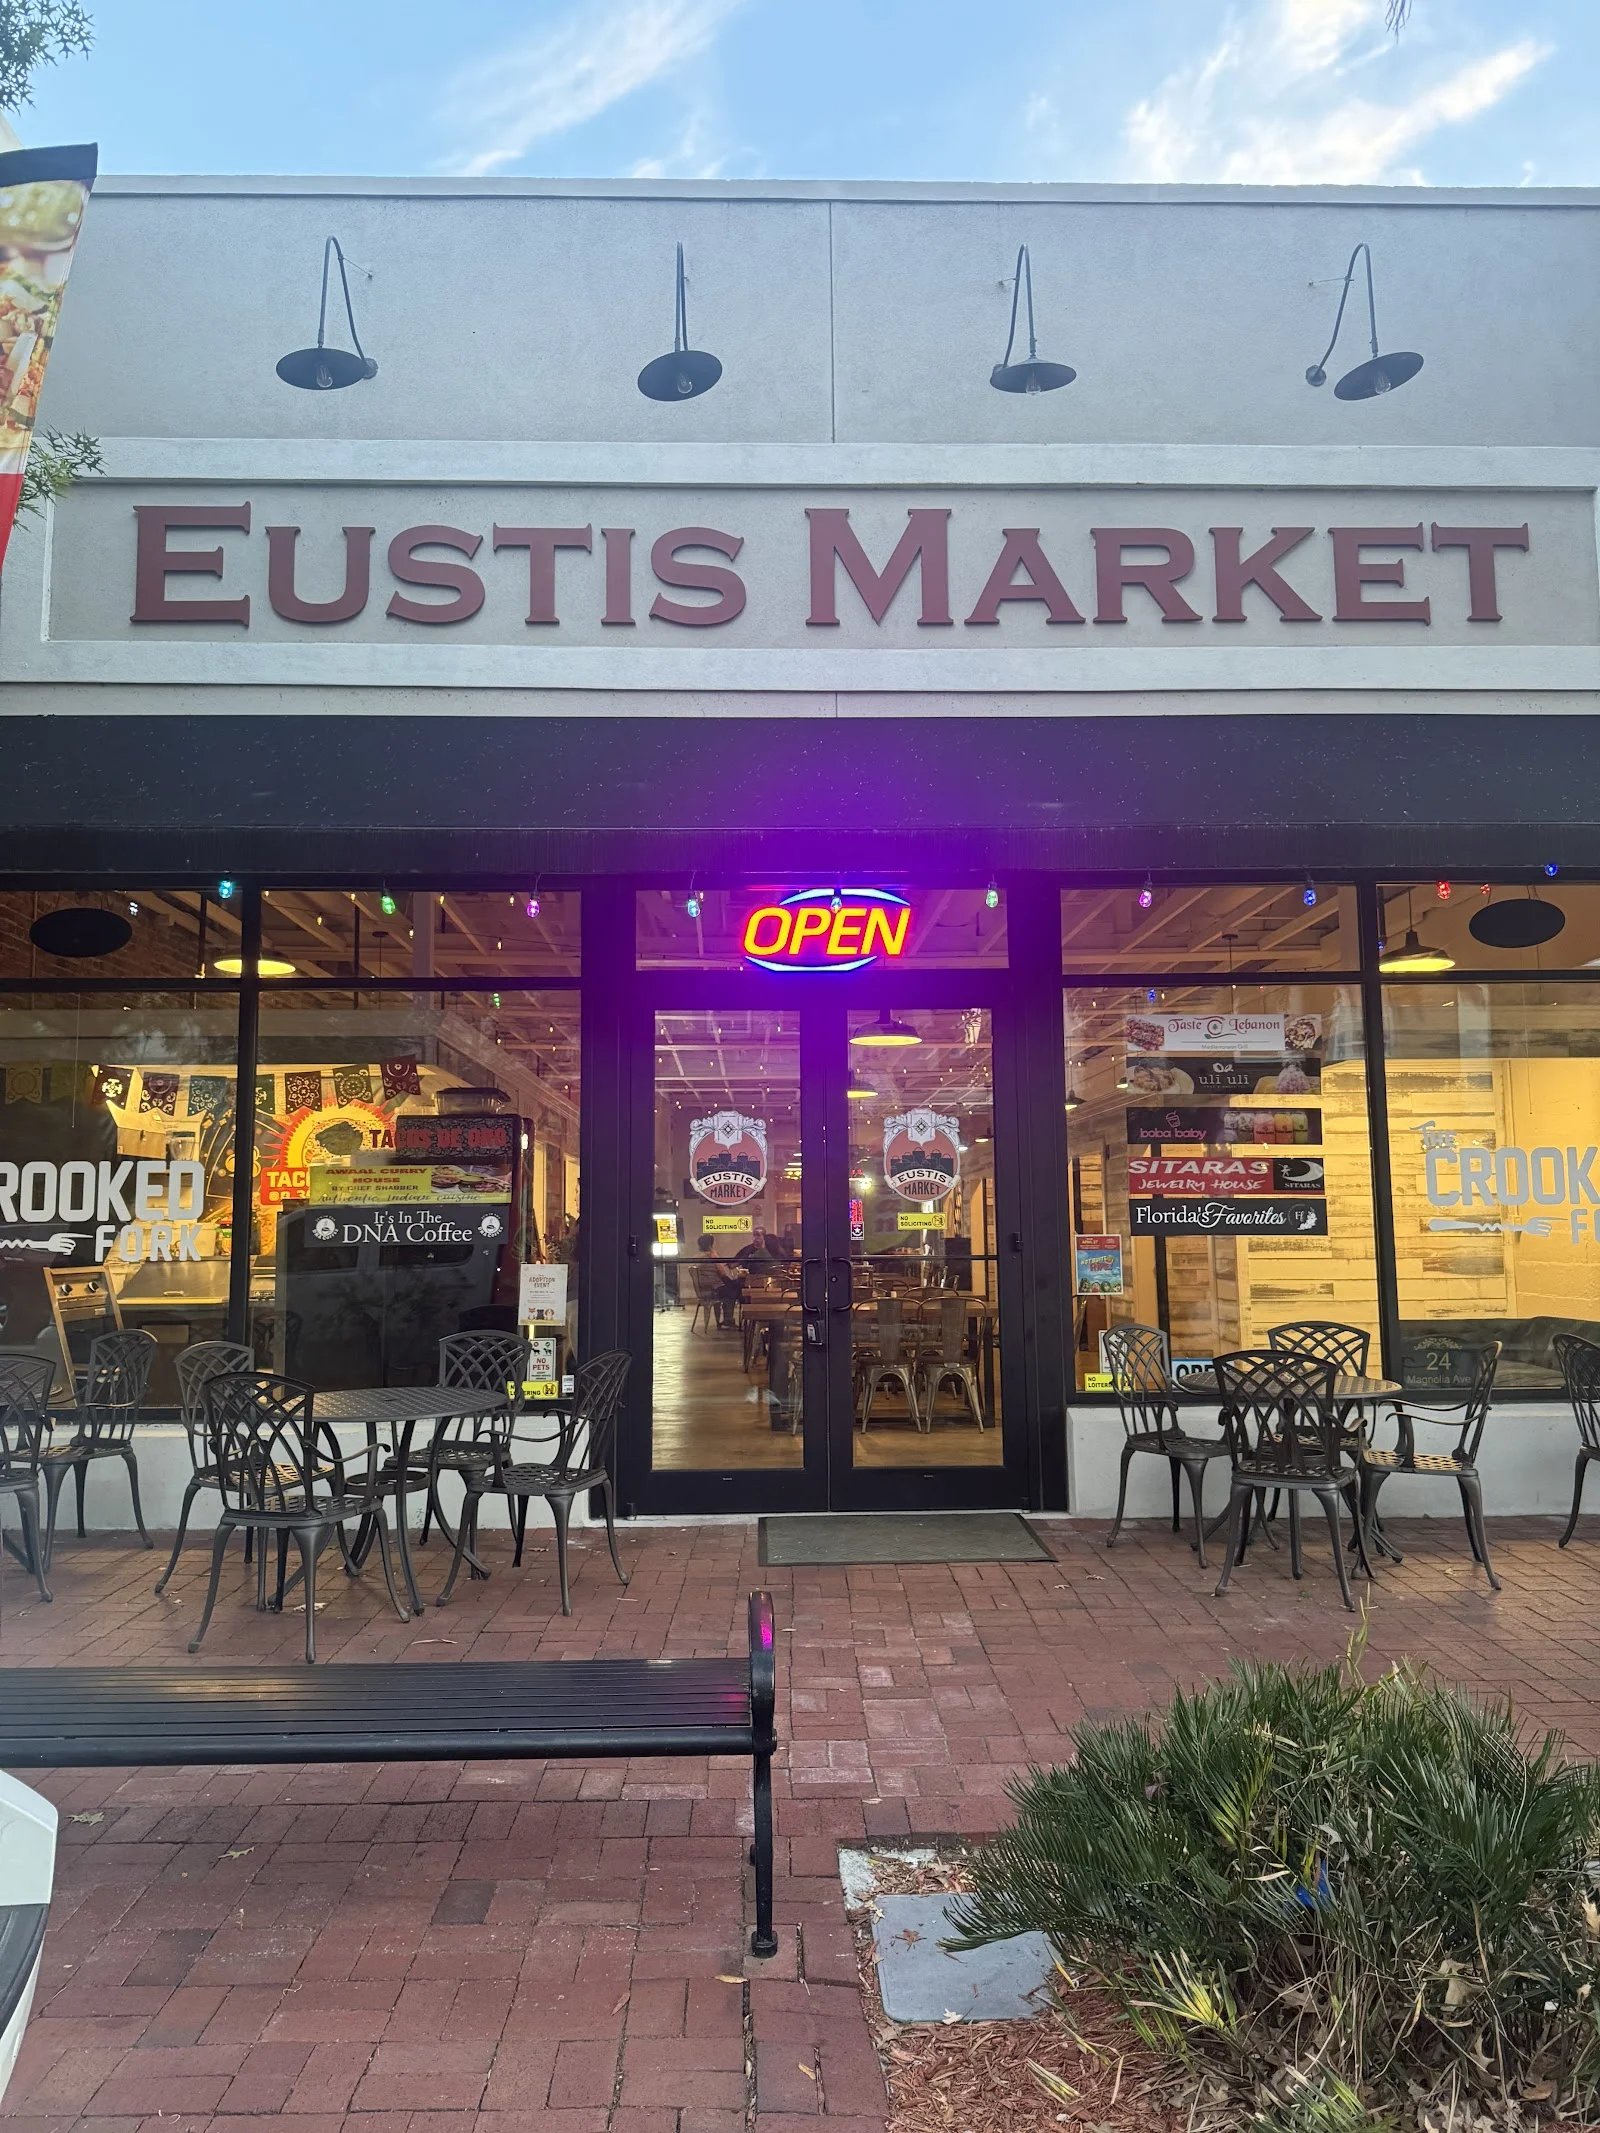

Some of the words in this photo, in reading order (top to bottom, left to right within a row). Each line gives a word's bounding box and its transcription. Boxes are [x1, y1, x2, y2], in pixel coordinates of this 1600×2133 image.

[130, 501, 747, 627] EUSTIS
[804, 507, 1529, 627] MARKET
[742, 906, 912, 956] OPEN
[1167, 1018, 1202, 1033] Taste
[1228, 1018, 1280, 1034] Lebanon
[1140, 1128, 1171, 1138] boba
[1175, 1128, 1207, 1140] baby
[1409, 1120, 1457, 1147] THE
[1128, 1160, 1270, 1175] SITARAS
[704, 1172, 754, 1186] EUSTIS
[897, 1169, 947, 1183] EUSTIS
[710, 1184, 747, 1198] MARKET
[904, 1181, 941, 1195] MARKET
[374, 1211, 395, 1223] It's
[398, 1211, 413, 1223] In
[417, 1211, 442, 1223] The
[1136, 1205, 1209, 1224] Florida's
[1197, 1202, 1287, 1228] Favorites
[342, 1223, 400, 1243] DNA
[405, 1222, 473, 1243] Coffee
[95, 1224, 202, 1262] FORK
[1426, 1352, 1452, 1371] 24
[1405, 1375, 1451, 1385] Magnolia
[1452, 1375, 1471, 1384] Ave
